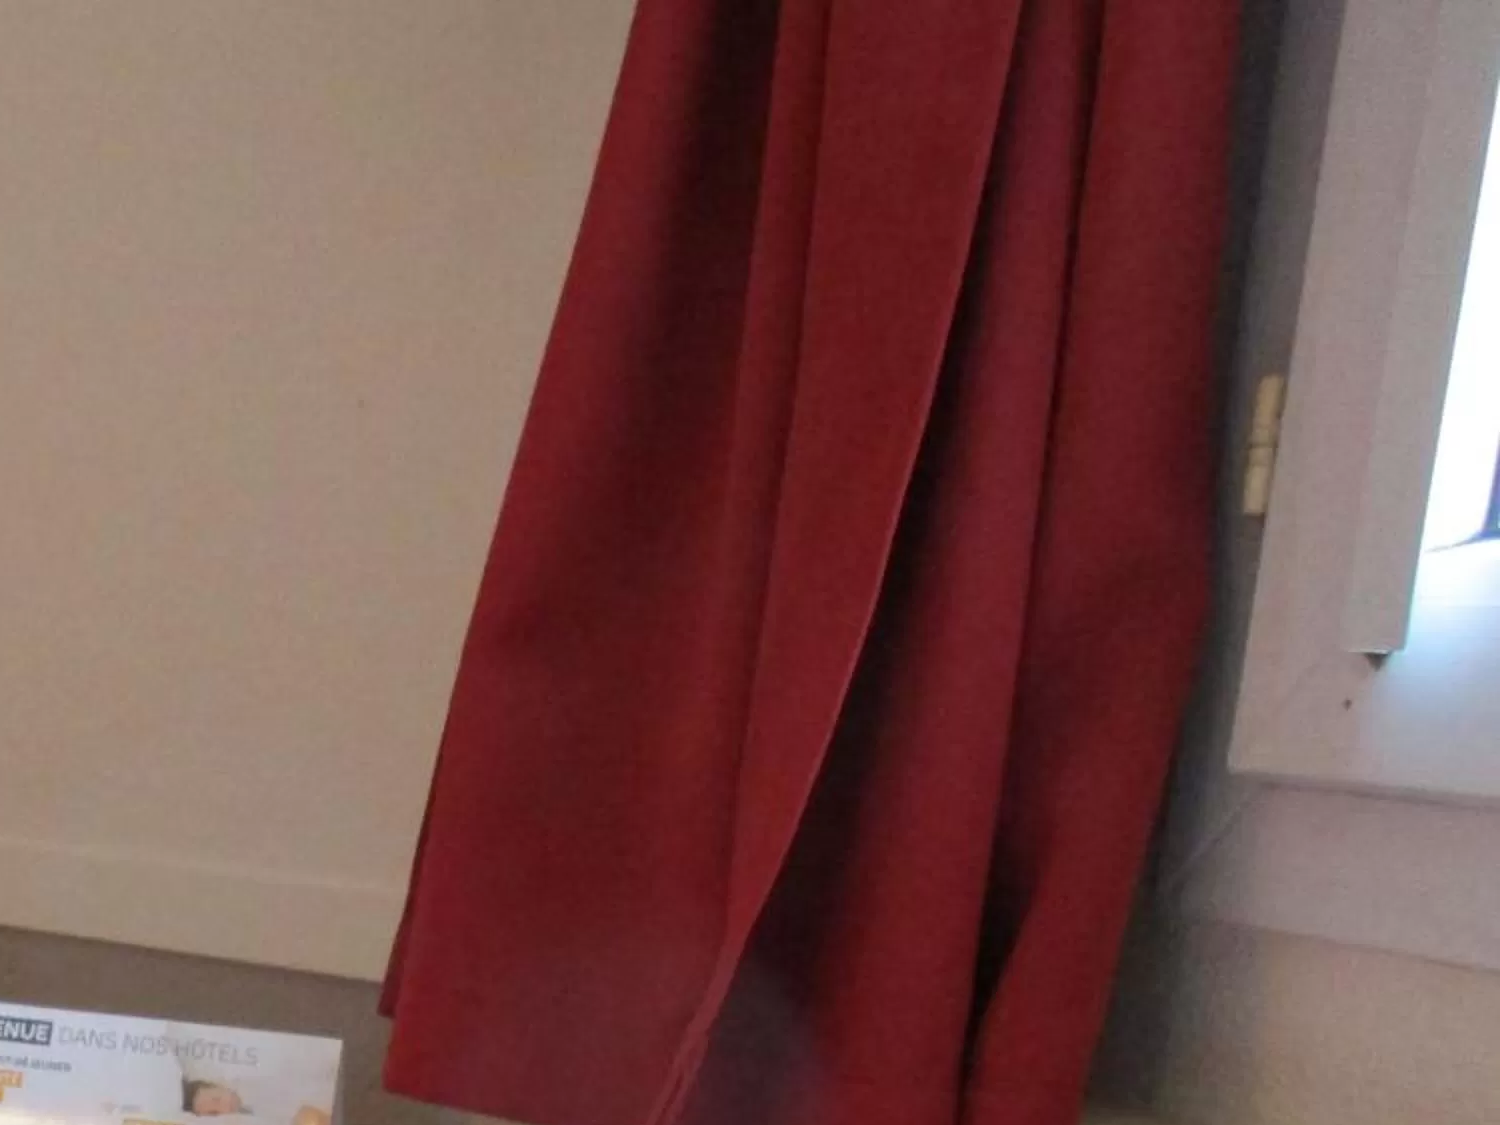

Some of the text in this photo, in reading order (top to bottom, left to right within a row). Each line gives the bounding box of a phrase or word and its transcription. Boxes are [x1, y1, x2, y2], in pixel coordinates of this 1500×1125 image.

[58, 1026, 118, 1051] DANS
[122, 1031, 167, 1055] NOS
[172, 1034, 259, 1067] HÔTELS
